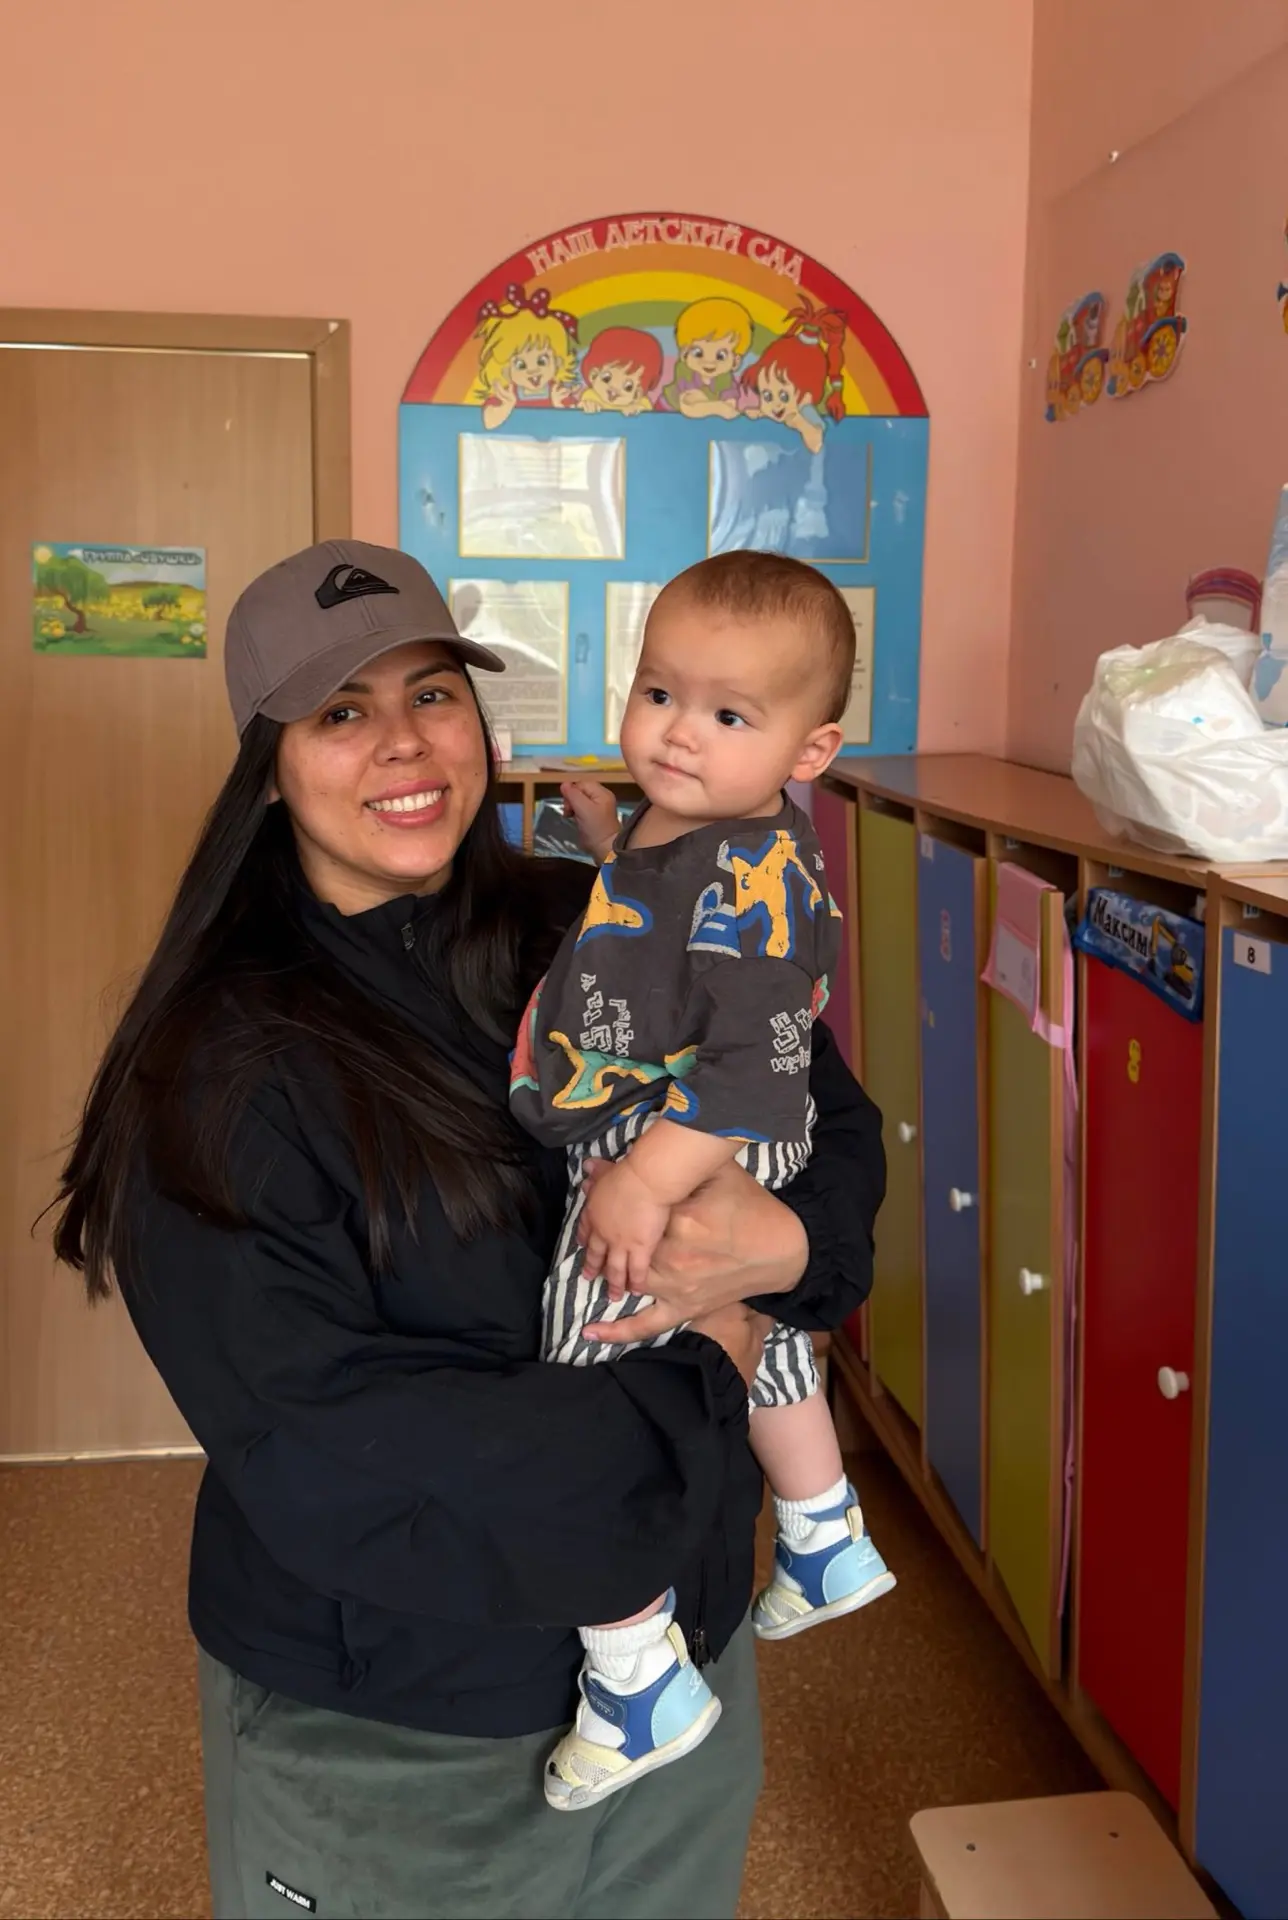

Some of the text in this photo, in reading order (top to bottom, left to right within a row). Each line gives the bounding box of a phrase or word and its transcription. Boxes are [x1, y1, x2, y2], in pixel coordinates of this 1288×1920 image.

[527, 219, 804, 285] НАШ ДЕТСКИЙ САД
[1092, 896, 1149, 958] Максим
[1247, 946, 1256, 964] 8
[270, 1879, 310, 1909] JUST WARM
